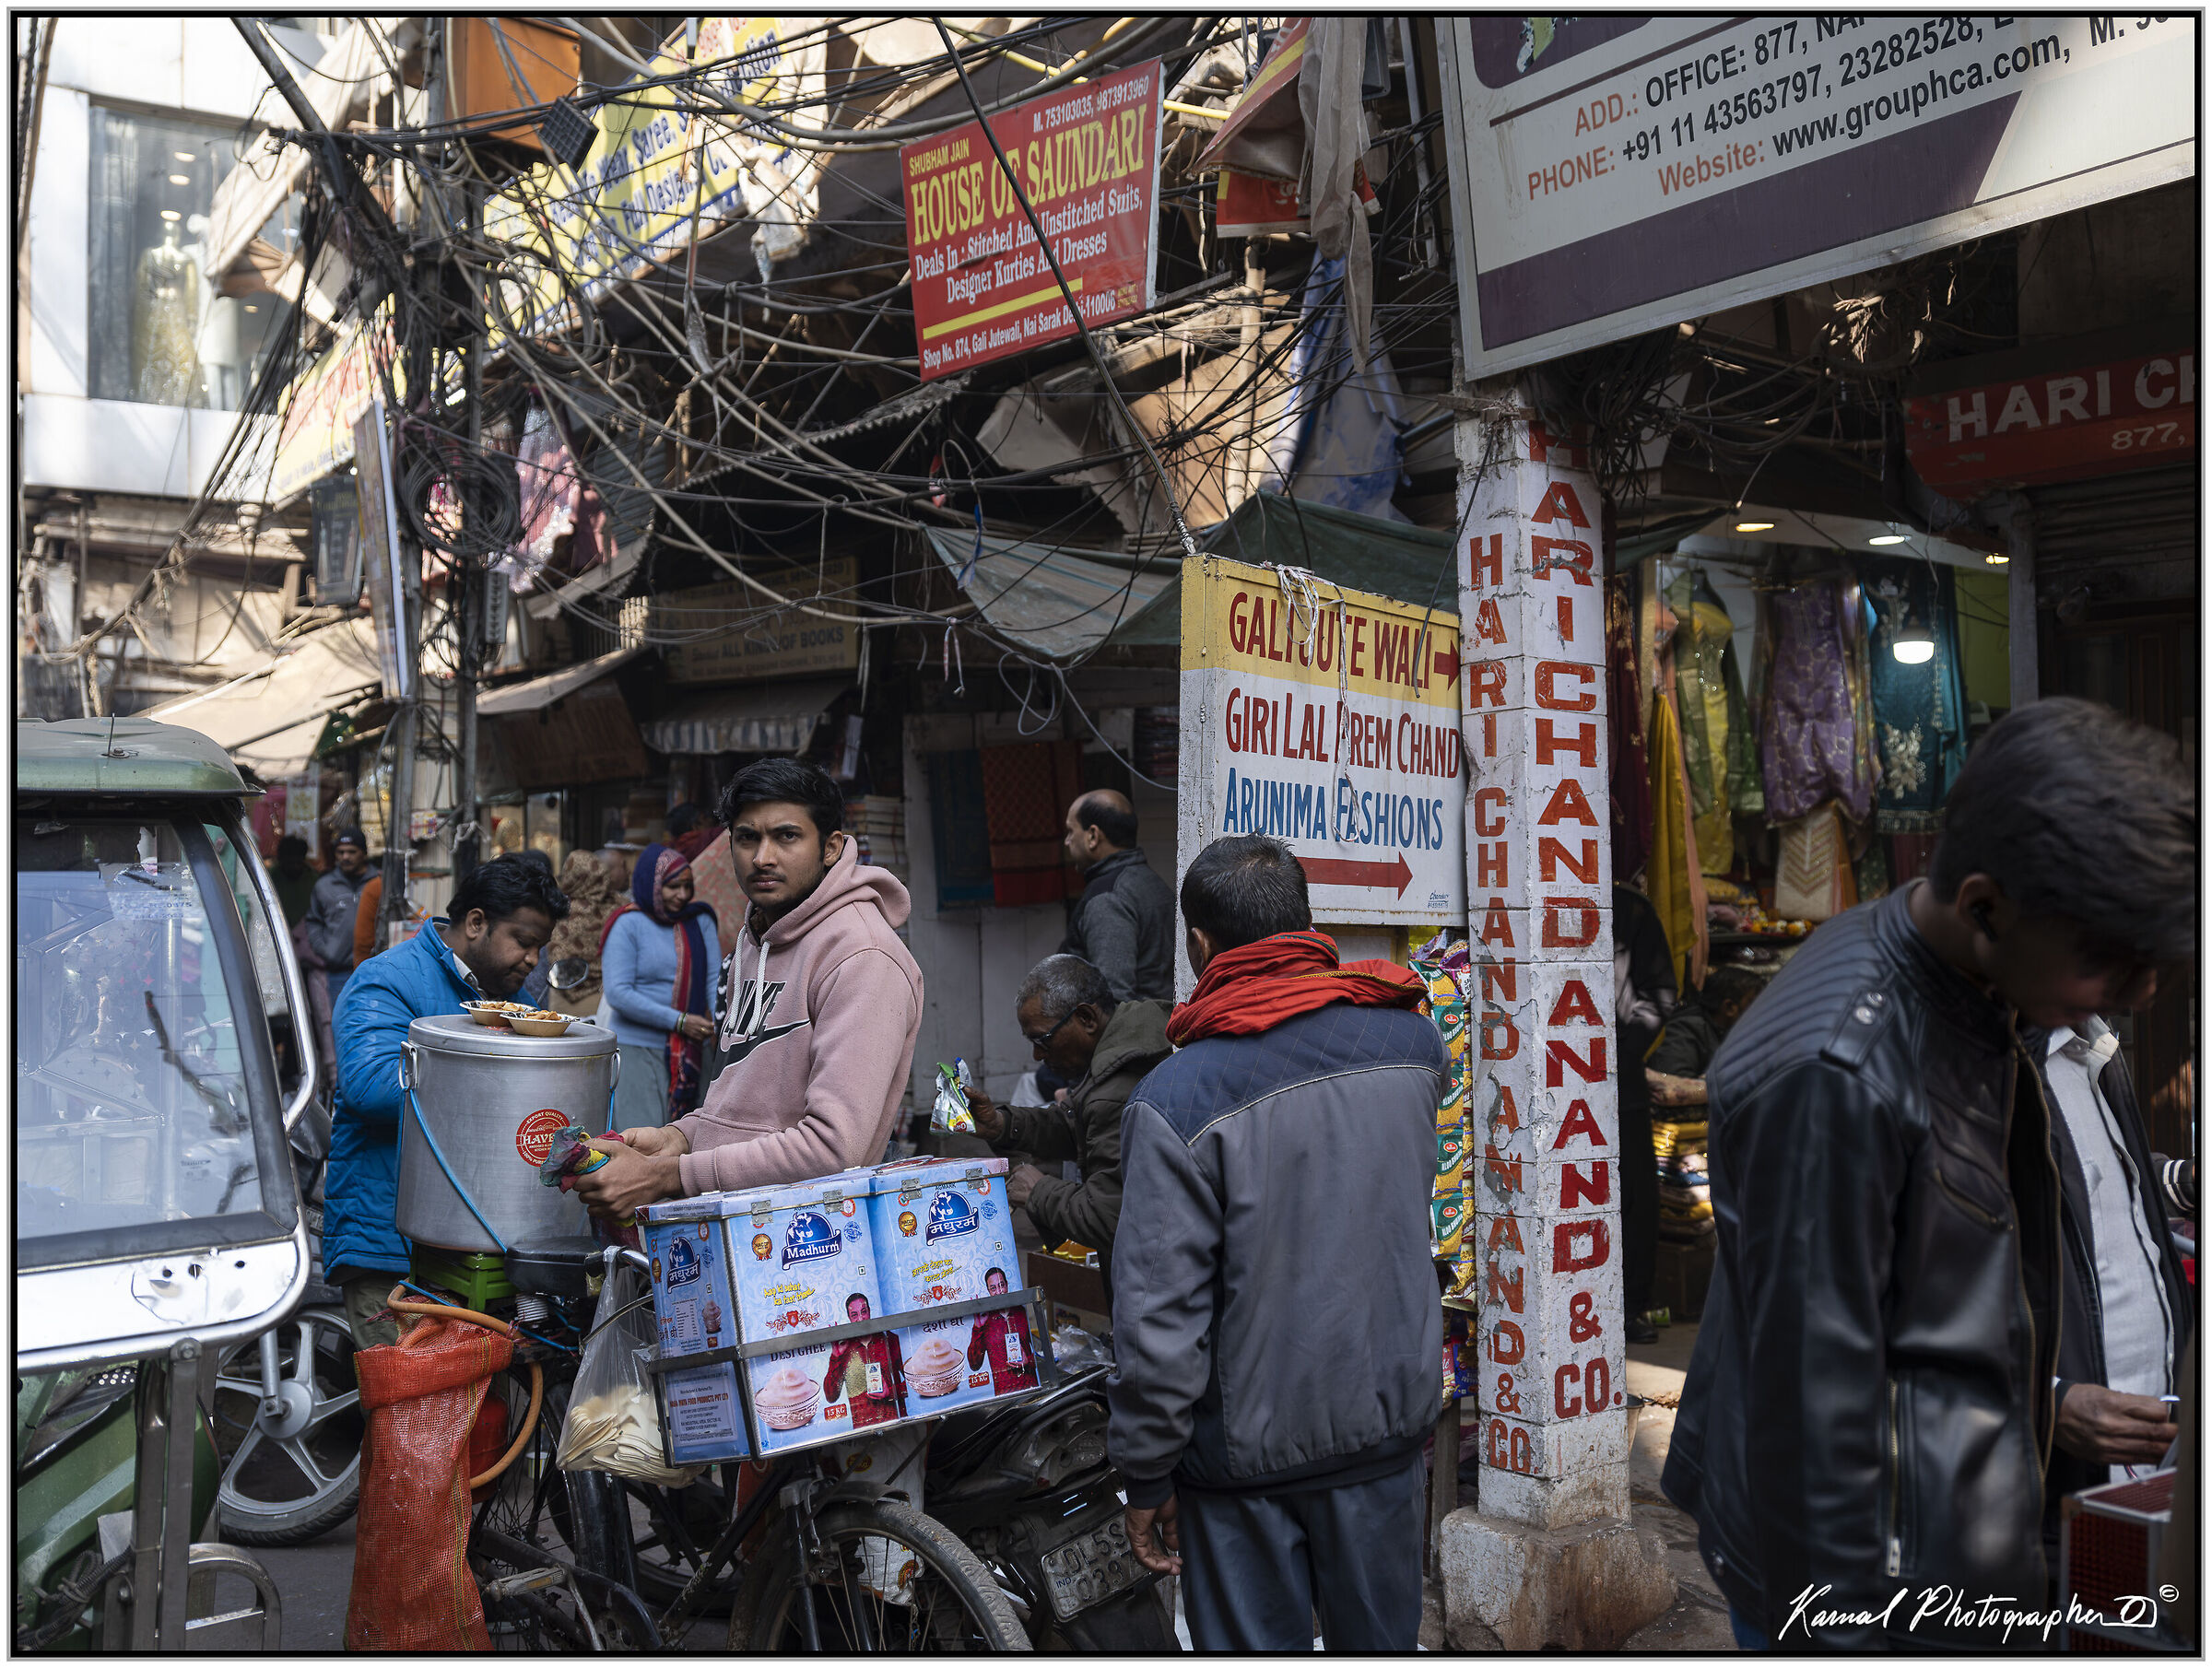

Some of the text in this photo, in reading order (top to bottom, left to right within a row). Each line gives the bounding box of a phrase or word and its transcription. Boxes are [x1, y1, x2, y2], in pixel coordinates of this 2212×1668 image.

[1033, 76, 1149, 133] M. 753103035, 9873913960
[1527, 18, 1983, 201] PHONE: +91 11 43563797, 23282528,
[1575, 91, 1639, 137] ADD.:
[1645, 45, 1747, 108] OFFICE:
[1755, 20, 1807, 65] 877,
[1658, 140, 1765, 196] Website:
[1771, 33, 2071, 158] www.grouphca.com,
[910, 138, 970, 177] SHUBHAM JAIN
[911, 103, 1147, 246] HOUSE OF SAUNDARI
[915, 250, 945, 282] Deals
[947, 244, 959, 271] In
[967, 221, 1013, 263] Stitched
[1041, 191, 1104, 238] Unstitched
[1108, 184, 1143, 217] Suits,
[947, 231, 1107, 305] Designer Kurties Ad Dresses
[924, 348, 941, 369] Shop
[942, 344, 955, 363] No.
[956, 339, 971, 359] 874,
[972, 333, 987, 352] Gali
[988, 320, 1023, 349] Jutewali,
[1024, 314, 1037, 334] Nai
[1039, 308, 1062, 333] Sarak
[1947, 370, 2112, 442] HARI
[2111, 422, 2185, 450] 877,
[801, 627, 844, 648] BOOKS
[1230, 592, 1295, 664] GALI
[1374, 619, 1432, 690] WALI
[1470, 533, 1508, 758] HARI
[1226, 687, 1460, 780] GIRI LAL PREM CHAND
[1223, 767, 1443, 852] ARUNIMA FASHIONS
[1474, 787, 1520, 1061] CHAND
[1529, 419, 1623, 1420] HARI CHAND ANAND & CO.
[929, 1216, 976, 1234] मधुरम
[668, 1263, 699, 1282] मधुरम
[771, 1343, 826, 1362] DESI GHEE
[971, 1373, 988, 1384] 15 KG
[827, 1406, 845, 1417] 15 KG
[1495, 1372, 1522, 1415] &
[1488, 1418, 1539, 1474] CO.
[1055, 1577, 1072, 1589] IND
